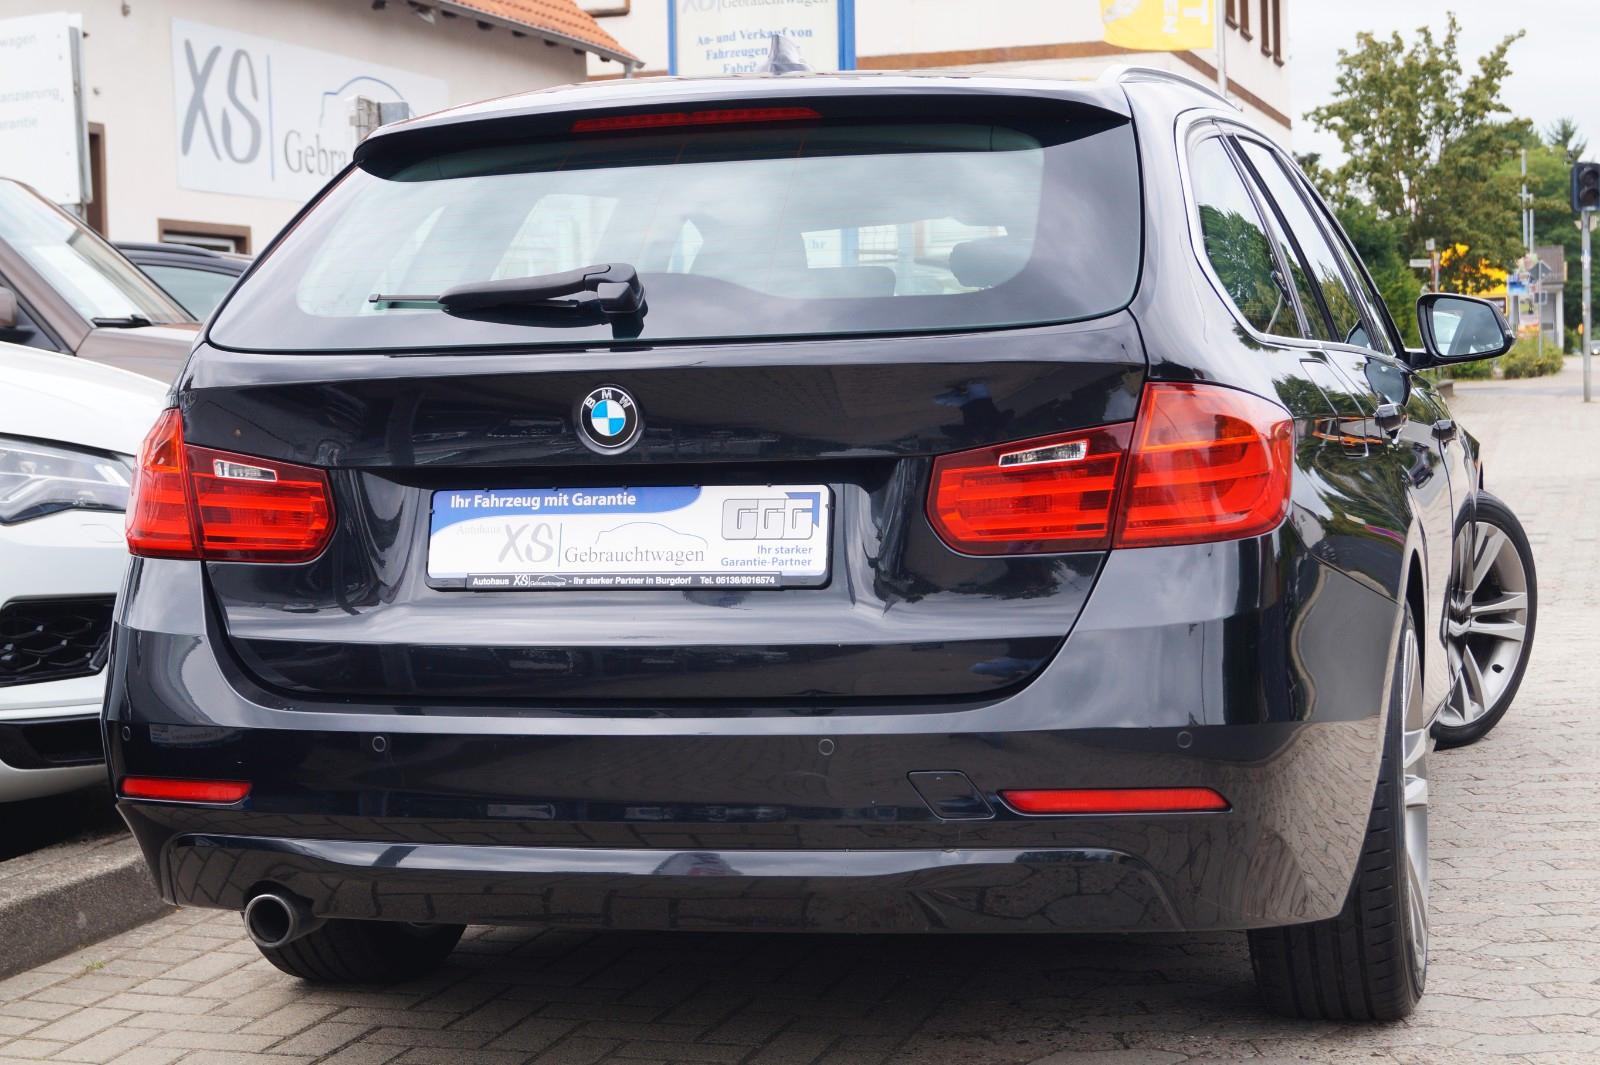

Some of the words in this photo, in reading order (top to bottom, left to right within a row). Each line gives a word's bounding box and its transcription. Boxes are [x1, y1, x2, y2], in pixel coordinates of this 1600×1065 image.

[716, 32, 736, 43] und
[790, 29, 813, 38] von
[705, 47, 769, 60] Fahrzeugen
[181, 38, 262, 164] XS
[585, 389, 631, 409] BMW
[451, 495, 471, 508] Ihr
[474, 494, 541, 510] Fahrzeug
[544, 493, 568, 507] mit
[572, 492, 636, 507] Garantie
[498, 522, 553, 563] XS
[757, 544, 772, 555] Ihr
[774, 545, 813, 555] starker
[565, 546, 705, 567] Gebrauchtwagen
[720, 557, 813, 567] Garantie-Partner
[472, 577, 509, 586] Autohaus
[513, 574, 529, 586] XS
[573, 577, 584, 585] Ihr
[586, 577, 613, 585] starker
[615, 576, 644, 585] Partner
[646, 576, 654, 585] in
[655, 576, 692, 586] Burgdorf
[700, 576, 714, 585] Tel.
